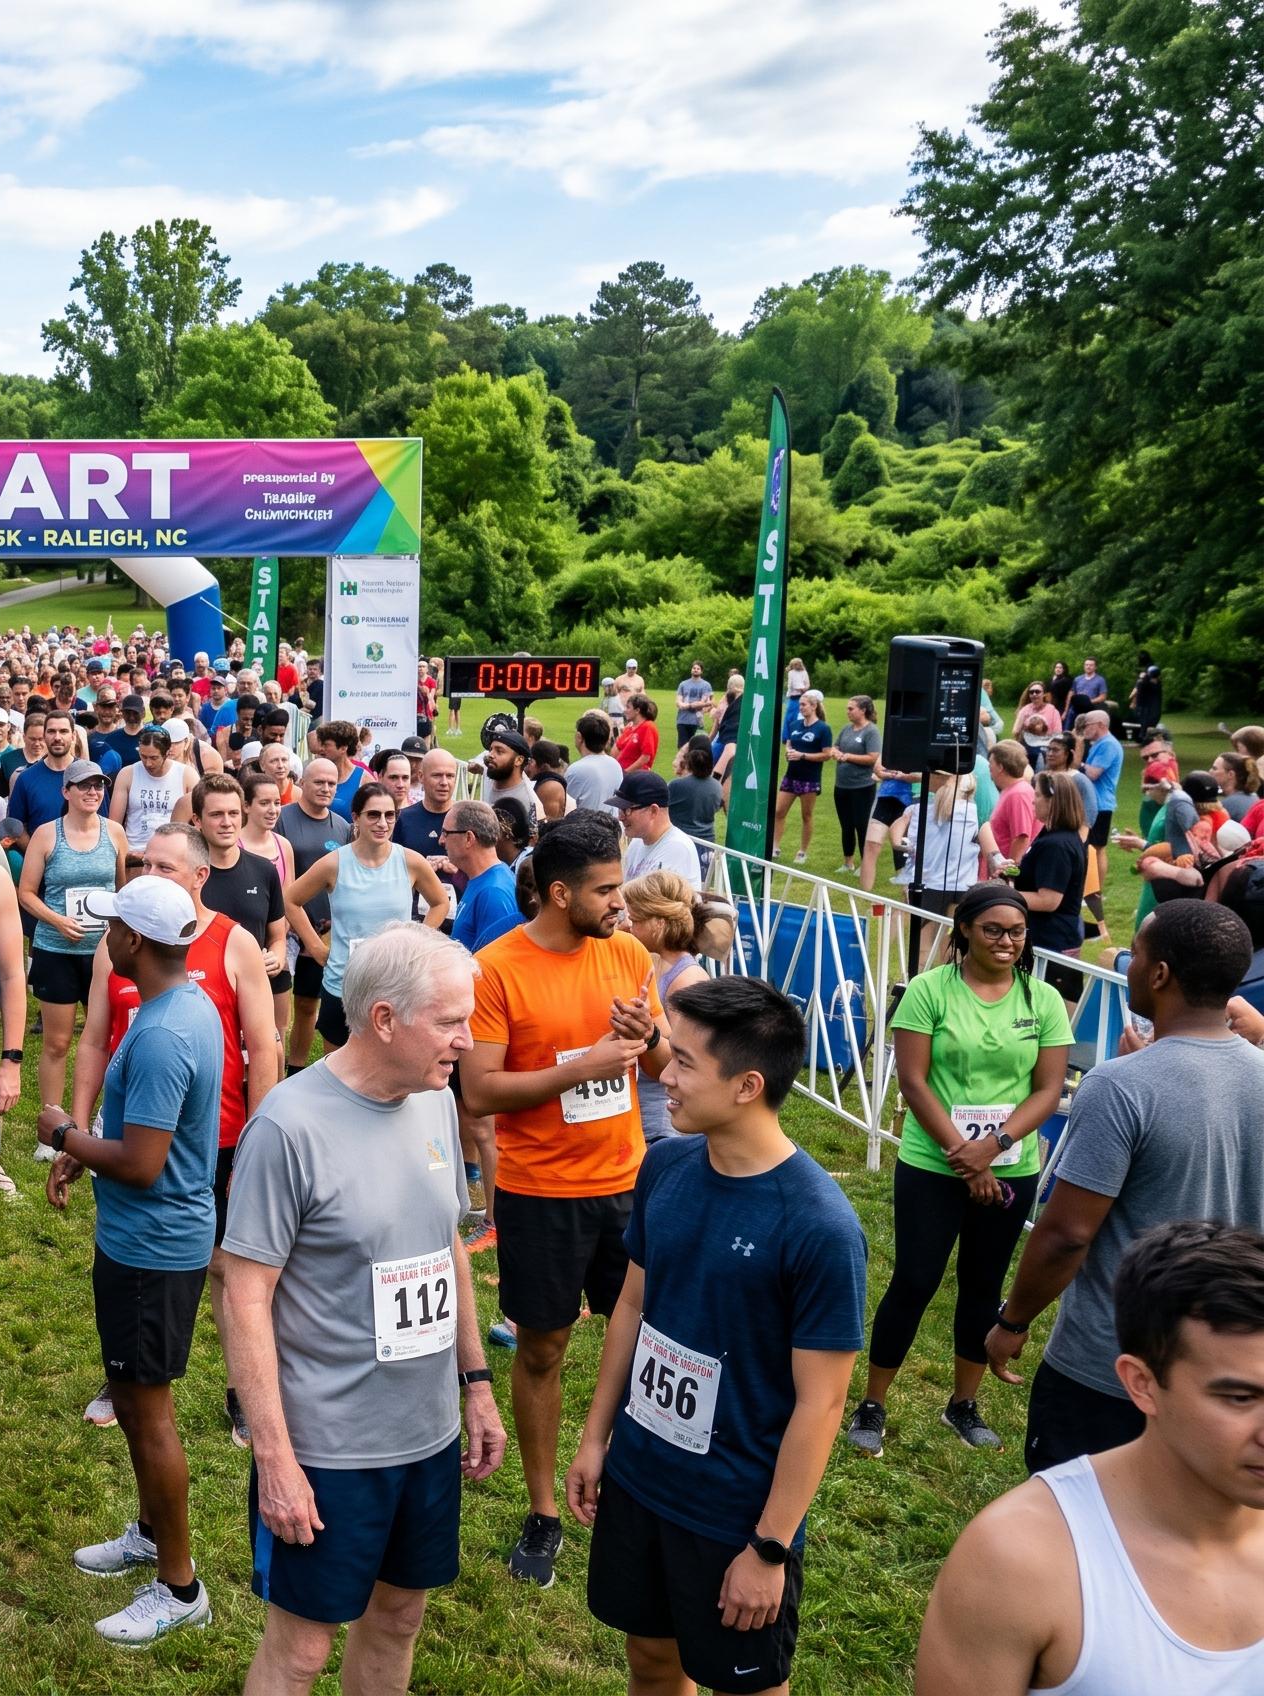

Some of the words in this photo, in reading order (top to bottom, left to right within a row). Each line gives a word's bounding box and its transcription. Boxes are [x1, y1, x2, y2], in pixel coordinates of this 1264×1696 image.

[43, 529, 148, 550] RALEIGH,
[156, 529, 188, 547] NC
[478, 663, 591, 691] 0:00:00
[394, 1277, 450, 1331] 112
[639, 1356, 699, 1420] 456
